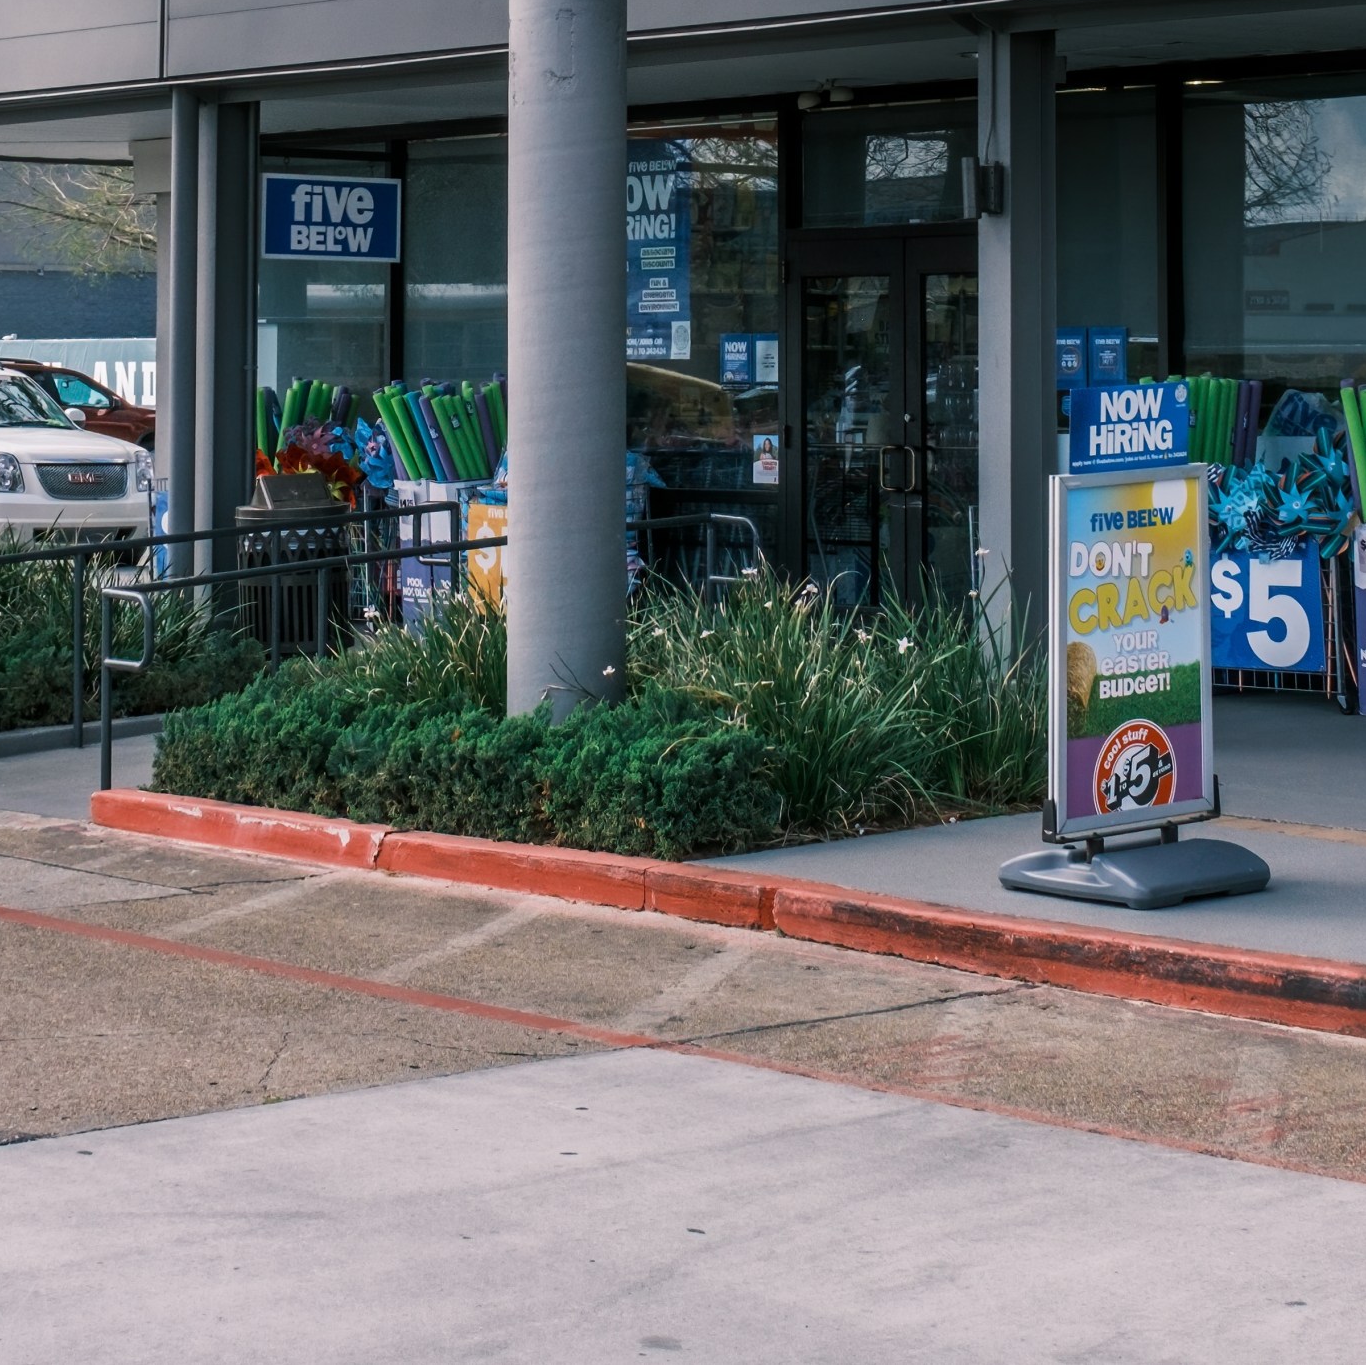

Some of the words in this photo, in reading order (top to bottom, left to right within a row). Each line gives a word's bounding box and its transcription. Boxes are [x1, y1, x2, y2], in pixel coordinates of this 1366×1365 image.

[291, 184, 375, 225] five
[626, 174, 676, 212] OW
[290, 225, 374, 253] BELOW
[724, 341, 747, 353] NOW
[1100, 388, 1164, 423] NOW
[68, 472, 104, 484] GMC
[1090, 512, 1124, 533] five
[1127, 507, 1175, 529] BELOW
[1069, 539, 1154, 577] DON'T
[406, 577, 424, 588] POOL
[1068, 563, 1198, 635] CRACK
[1210, 553, 1311, 668] $5
[1113, 631, 1159, 652] YOUR
[1104, 739, 1122, 769] cool
[1122, 728, 1148, 745] stuff
